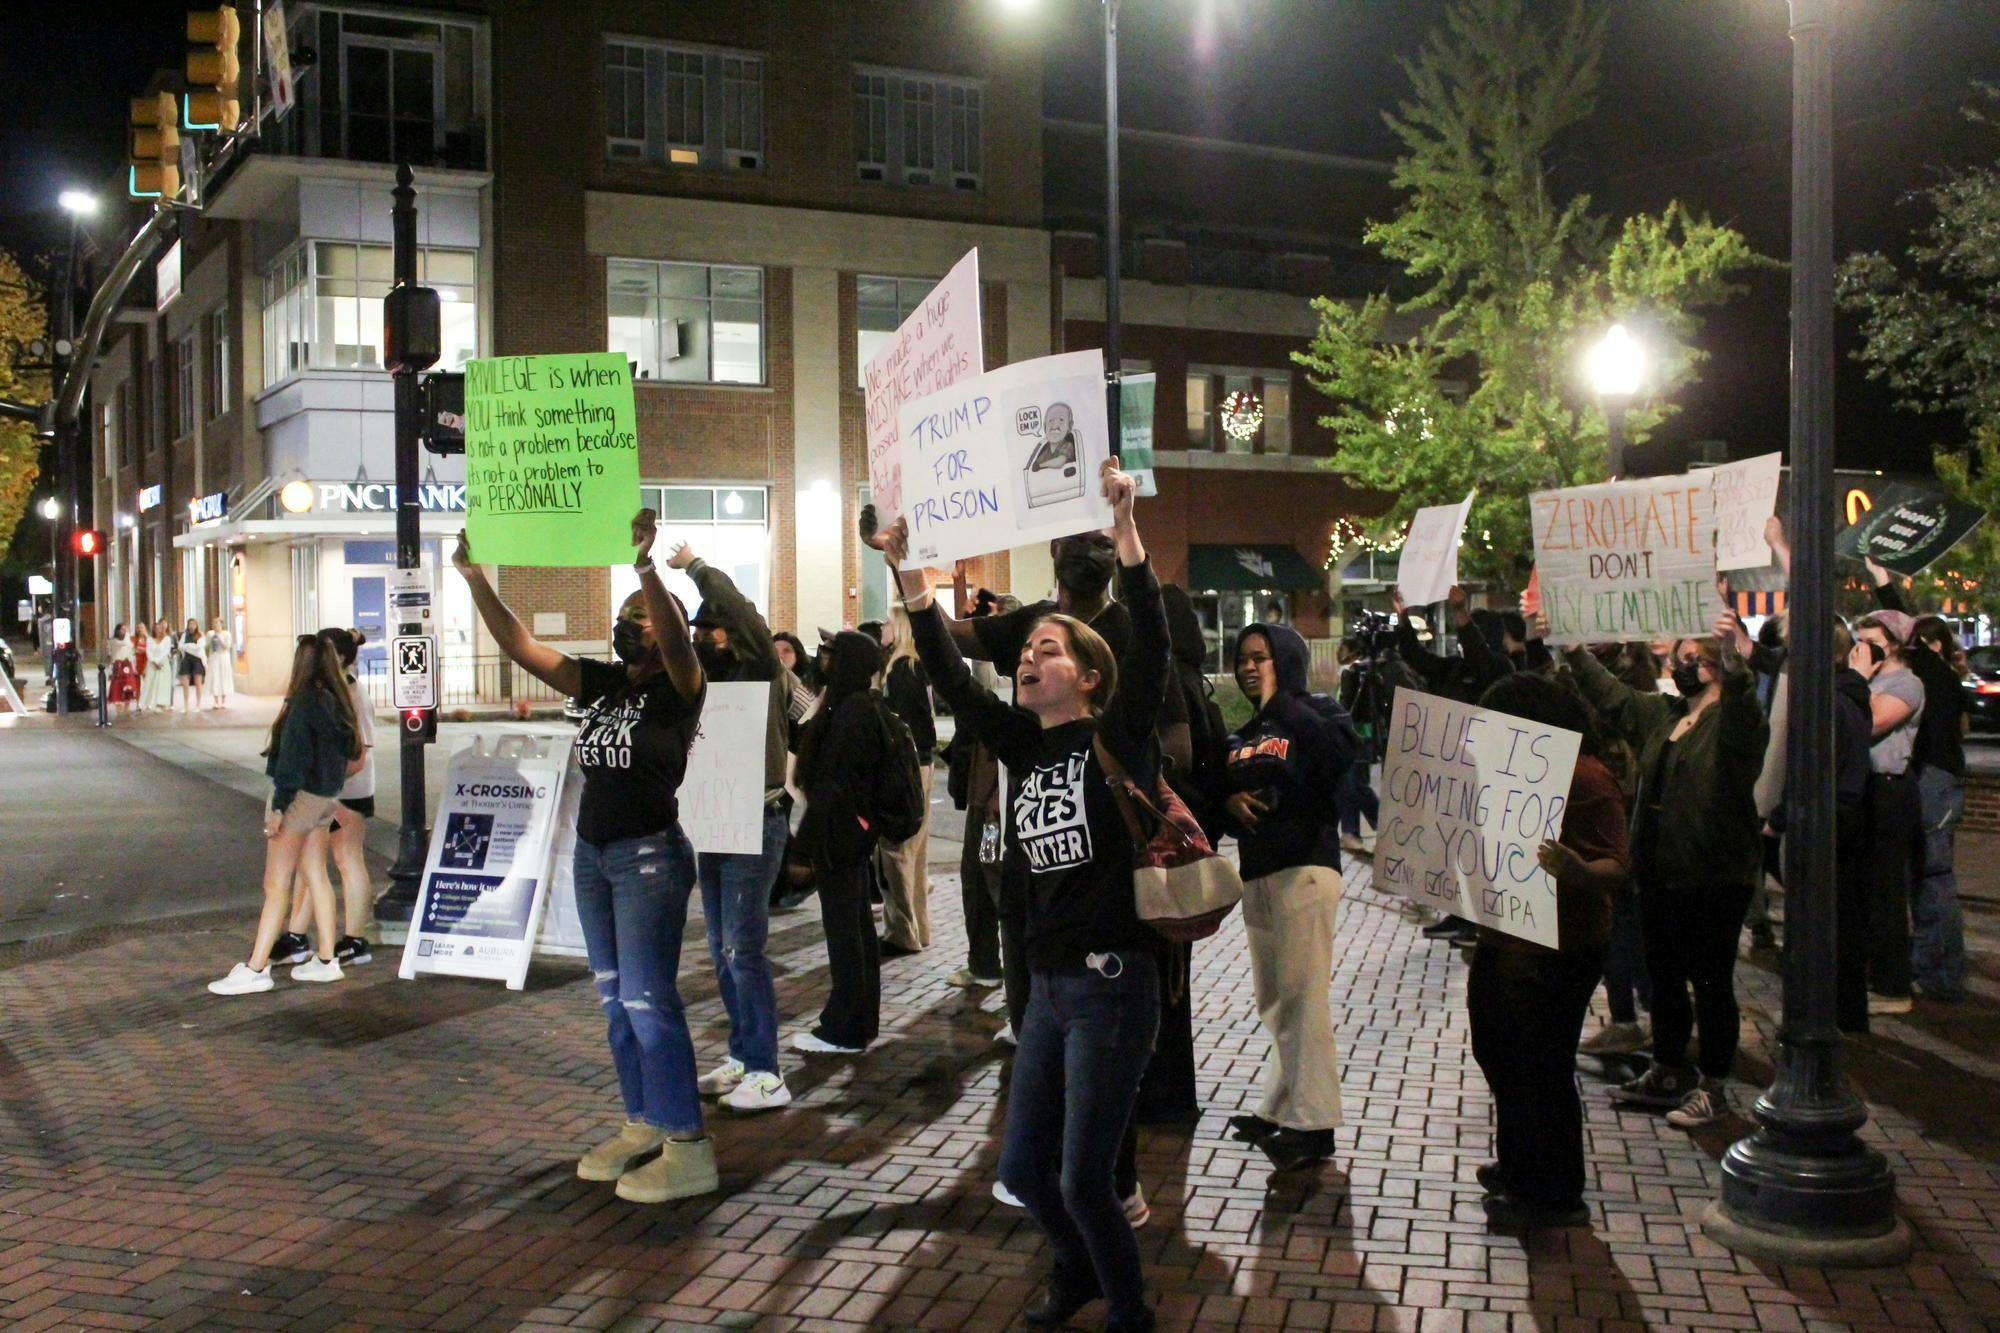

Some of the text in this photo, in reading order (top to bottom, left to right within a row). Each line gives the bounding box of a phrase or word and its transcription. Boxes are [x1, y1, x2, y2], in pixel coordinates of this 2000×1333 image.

[466, 357, 621, 397] PRIVILEGE is when
[466, 399, 615, 434] YOU think something
[910, 396, 991, 451] TRUMP
[1019, 410, 1038, 421] LOCK
[1020, 421, 1039, 431] EM UP
[479, 434, 494, 457] not
[500, 443, 507, 456] a
[514, 433, 570, 465] problem
[577, 428, 636, 452] because
[484, 464, 504, 483] not
[510, 470, 518, 482] a
[524, 461, 581, 486] problem
[588, 458, 604, 475] to
[933, 449, 974, 485] FOR
[319, 485, 384, 510] PNC
[488, 481, 582, 510] PERSONALLY
[913, 486, 999, 535] PRISON
[1589, 551, 1653, 579] DONT
[1541, 580, 1709, 634] DISCRIMINATE
[576, 719, 639, 746] LACK
[1401, 703, 1552, 784] BLUE IS
[606, 746, 631, 769] DO
[455, 783, 546, 799] X-CROSSING
[1389, 766, 1565, 843] COMING FOR
[1436, 822, 1500, 882] YOU
[435, 880, 460, 890] Here's
[460, 881, 478, 890] how
[1443, 877, 1463, 905] GA
[1510, 896, 1536, 929] PA
